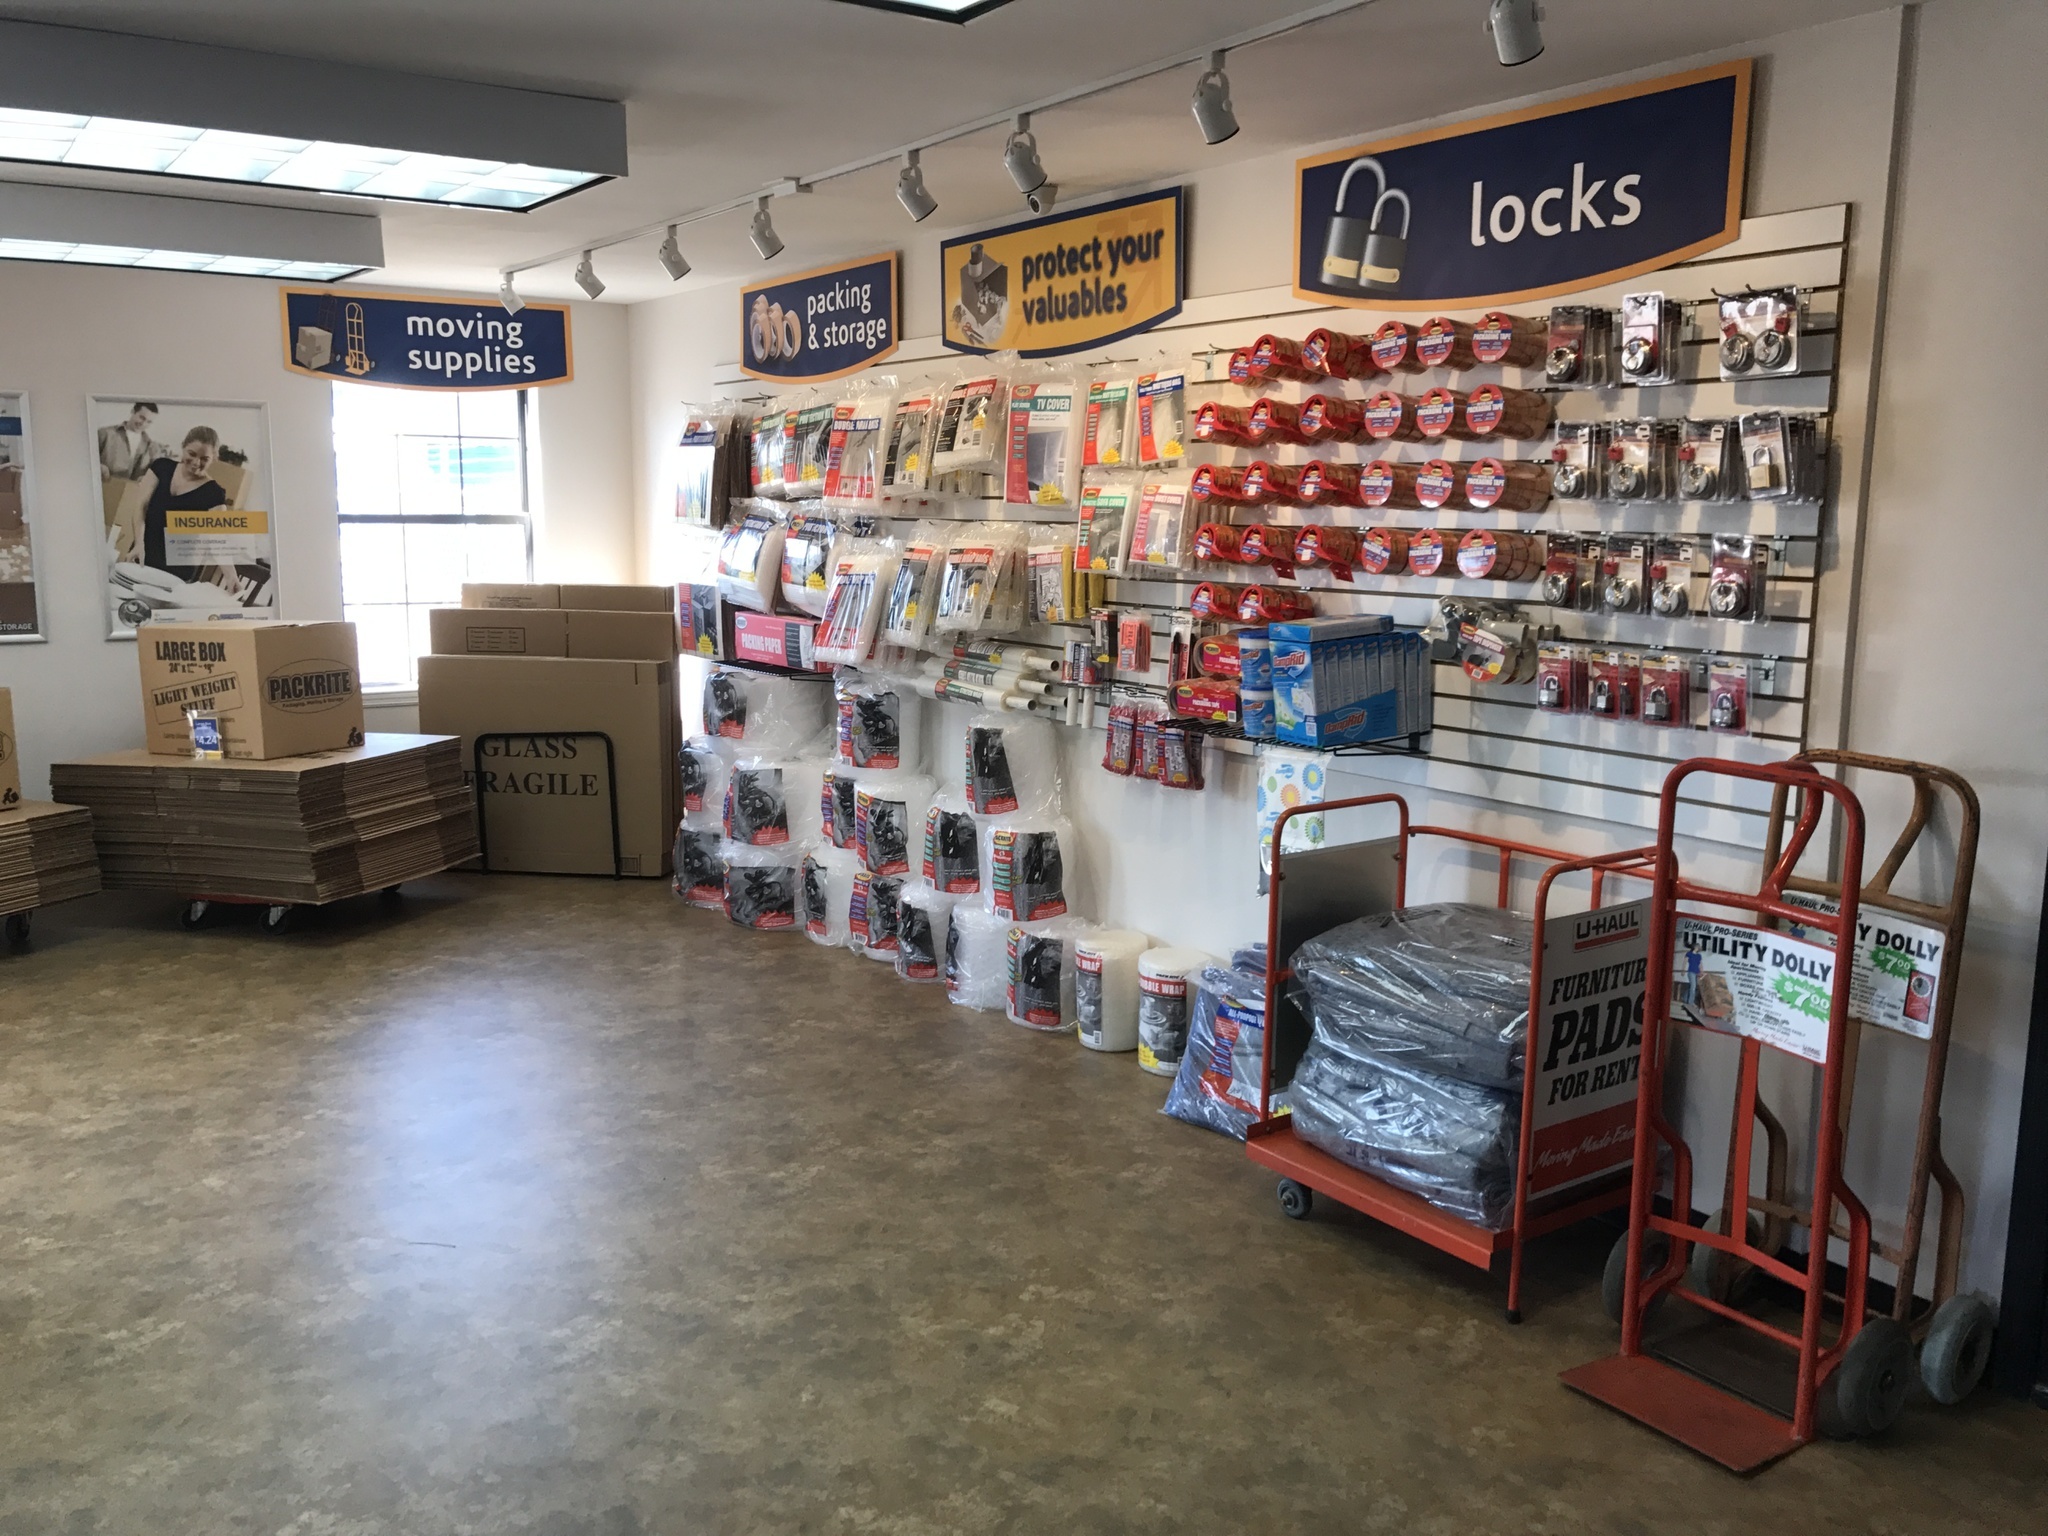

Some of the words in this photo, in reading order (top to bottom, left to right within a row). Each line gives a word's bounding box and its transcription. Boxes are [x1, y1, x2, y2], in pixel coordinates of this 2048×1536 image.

[1470, 162, 1642, 246] locks
[1022, 236, 1103, 292] protect
[1107, 228, 1164, 278] your
[807, 279, 871, 323] packing
[1022, 277, 1127, 325] valuables
[406, 312, 524, 348] moving
[808, 323, 820, 350] &
[823, 318, 887, 350] storage
[408, 346, 536, 378] supplies
[1037, 398, 1046, 409] TV
[1047, 399, 1070, 410] COVER
[174, 517, 248, 528] INSURANCE
[155, 641, 196, 661] LARGE
[198, 642, 226, 662] BOX
[742, 633, 764, 651] PACKING
[765, 637, 783, 654] PAPER
[1273, 651, 1306, 669] DampRid
[154, 687, 188, 706] LIGHT
[191, 677, 236, 698] WEIGHT
[269, 671, 351, 701] PACKRITE
[181, 697, 215, 716] STUFF
[1324, 710, 1366, 735] DampRid
[480, 737, 577, 760] GLASS
[463, 770, 599, 796] FRAGILE
[1790, 897, 1820, 910] U-HAUL
[1576, 910, 1639, 939] U-HAUL
[1684, 920, 1713, 934] U-HAUL
[1714, 925, 1758, 941] PRO-SERIES
[1683, 932, 1768, 963] UTILITY
[1771, 949, 1832, 983] DOLLY
[1876, 928, 1939, 962] DOLLY
[1082, 960, 1100, 971] WRAP
[1139, 978, 1160, 993] UBBLE
[1162, 984, 1185, 995] WRAP
[1549, 958, 1648, 1006] FURNITUR
[1542, 990, 1645, 1072] PADS
[1547, 1070, 1589, 1105] FOR
[1590, 1054, 1641, 1093] RENT
